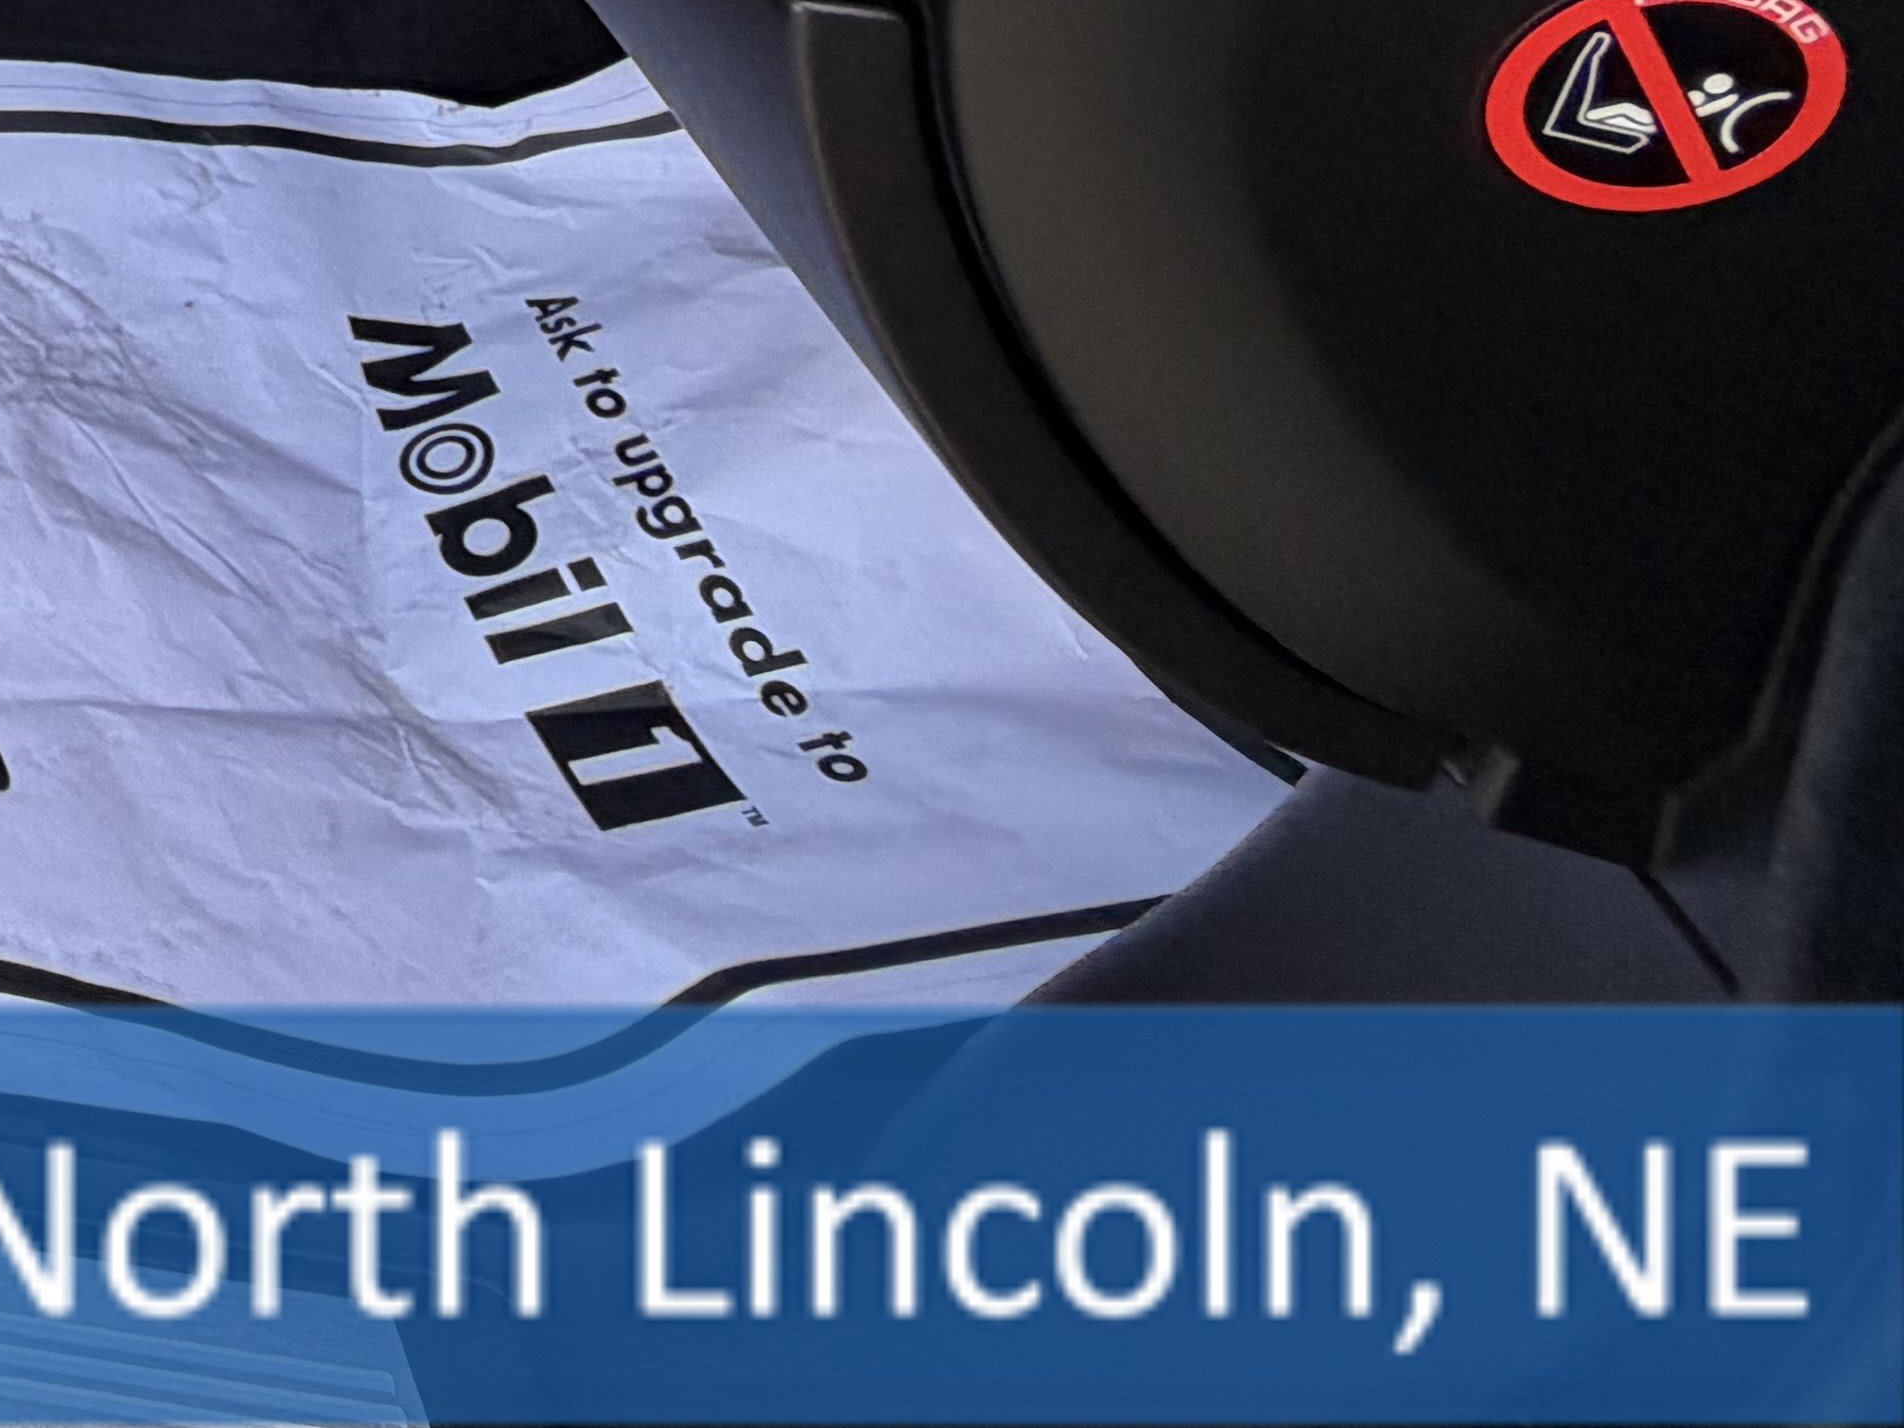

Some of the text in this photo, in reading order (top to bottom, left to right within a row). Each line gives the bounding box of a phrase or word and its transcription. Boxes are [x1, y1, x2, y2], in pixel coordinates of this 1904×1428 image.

[347, 314, 635, 665] Mobil
[525, 296, 869, 782] Ask to upgrade to
